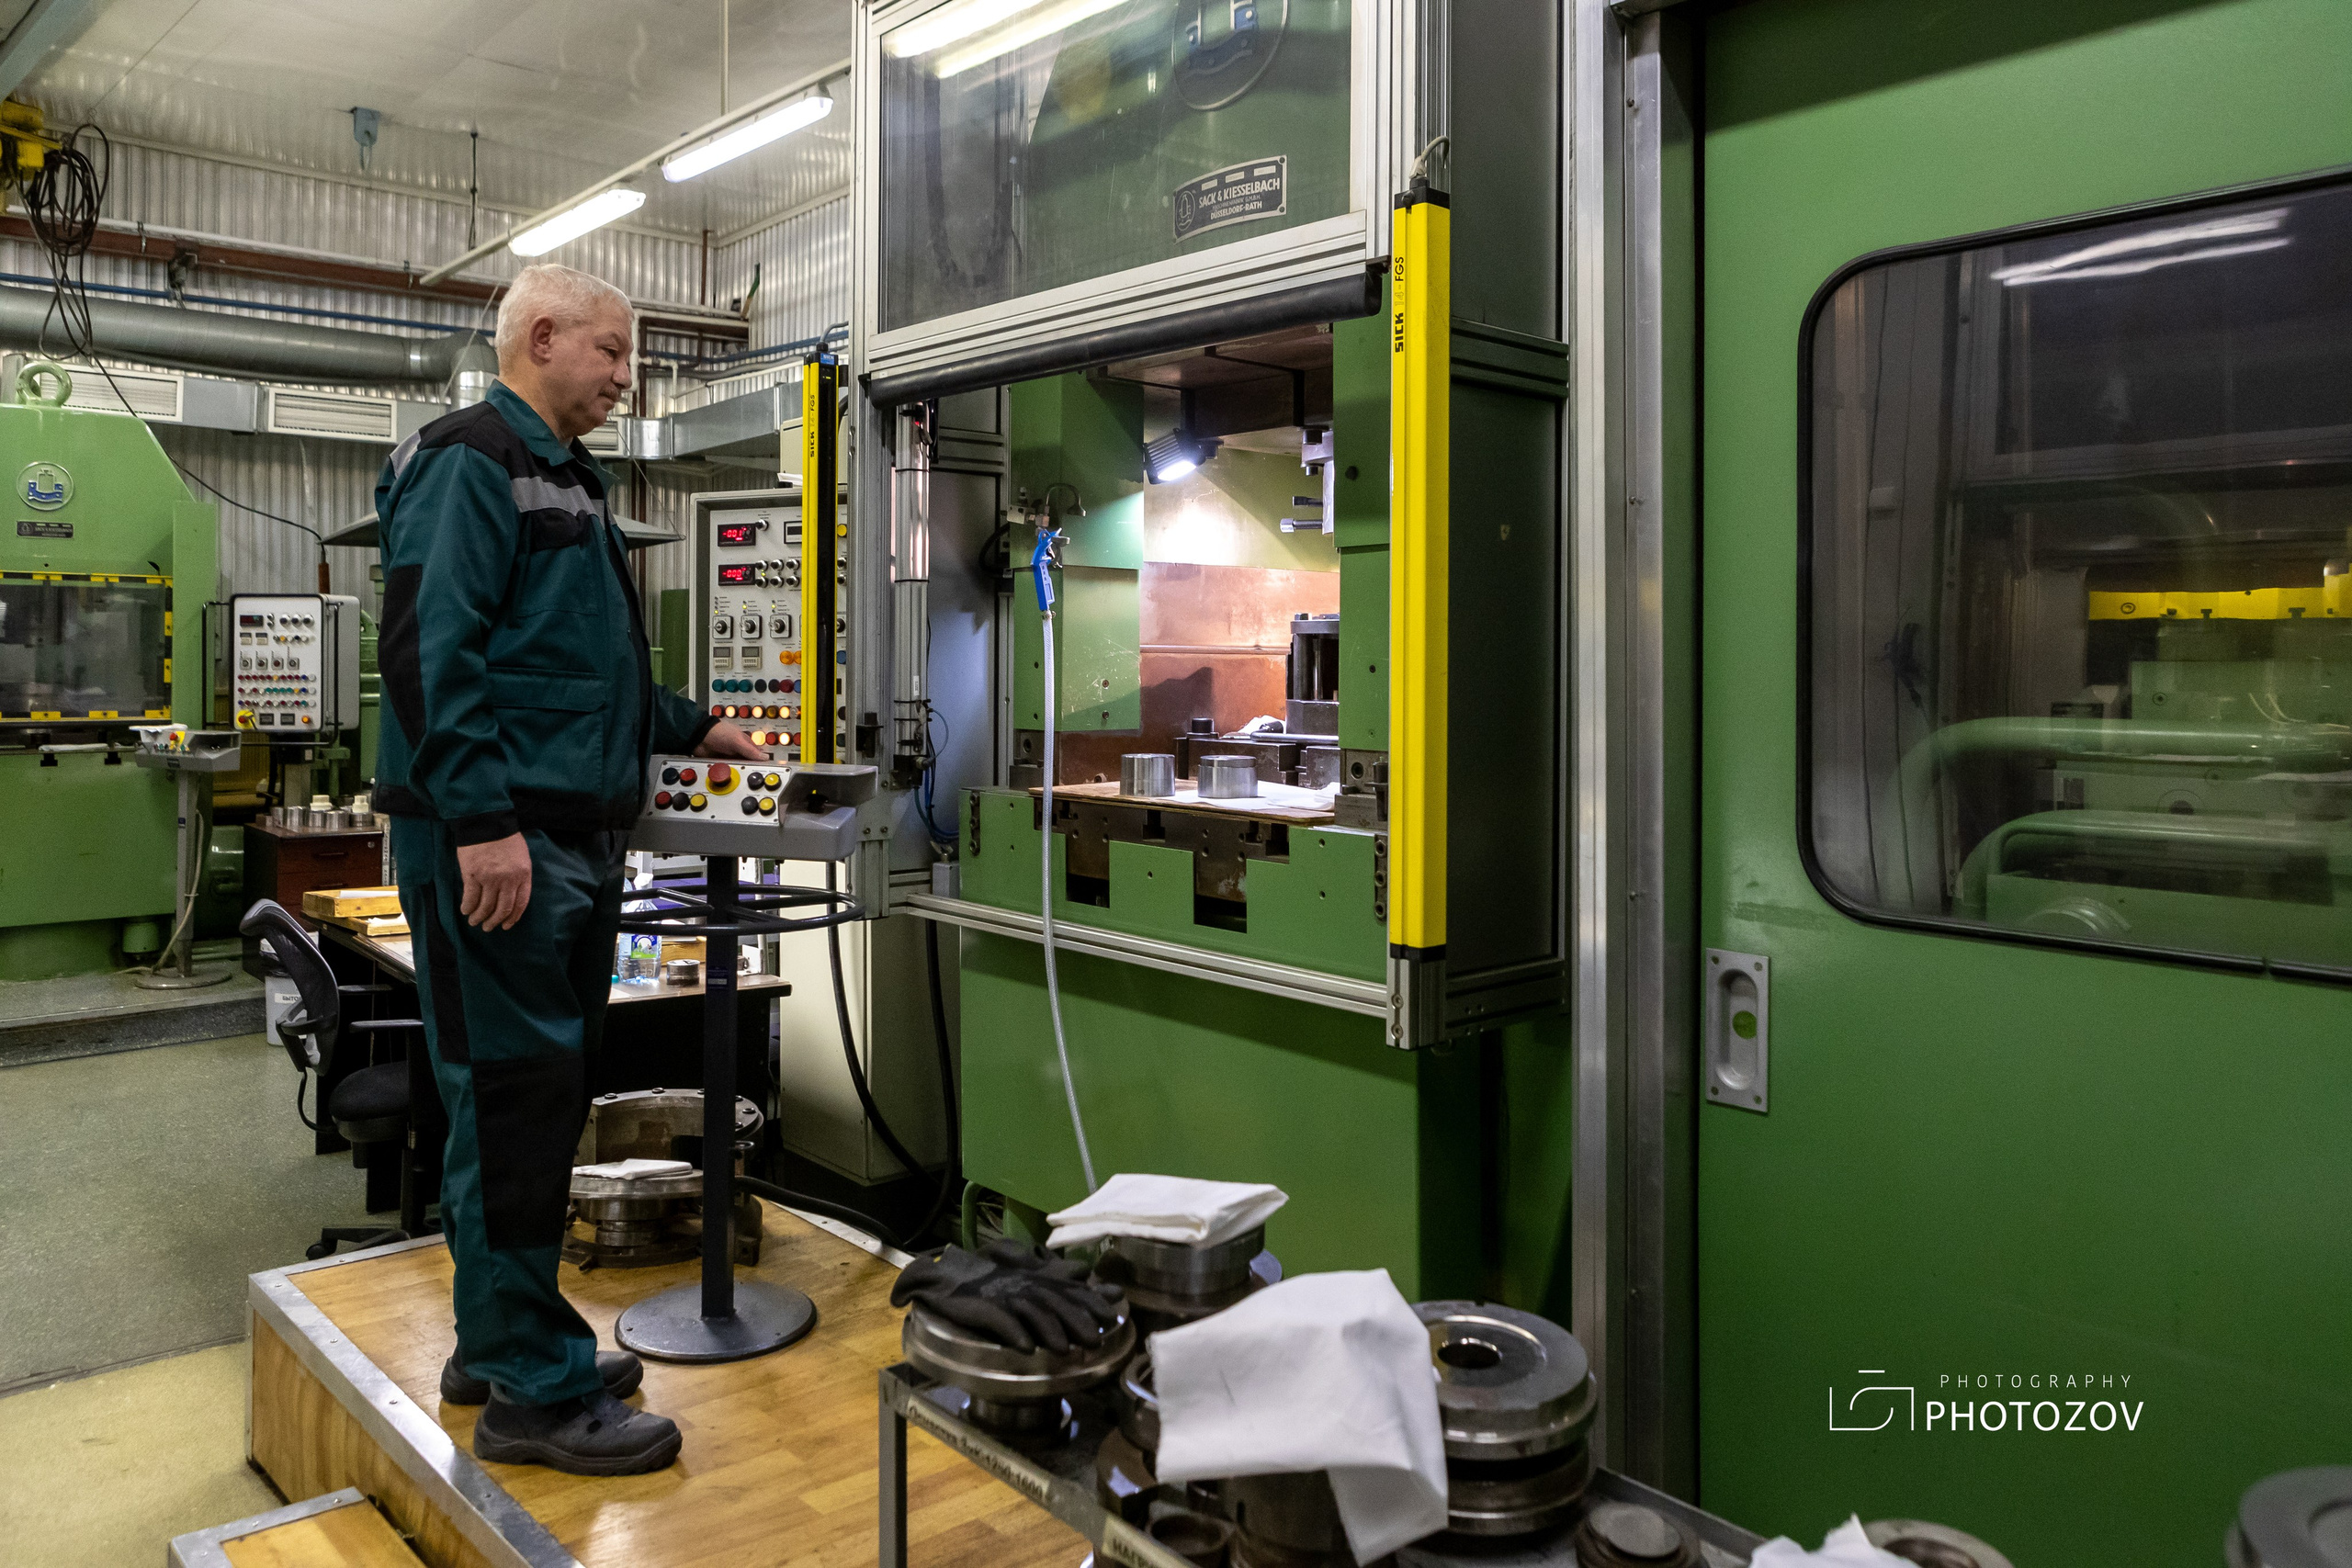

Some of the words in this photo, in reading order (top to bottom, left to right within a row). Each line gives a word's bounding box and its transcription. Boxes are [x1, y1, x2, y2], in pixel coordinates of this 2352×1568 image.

[1198, 194, 1216, 209] SACK
[1217, 190, 1222, 202] &
[1223, 177, 1280, 200] KIESSELBACH
[1395, 312, 1404, 353] SICK
